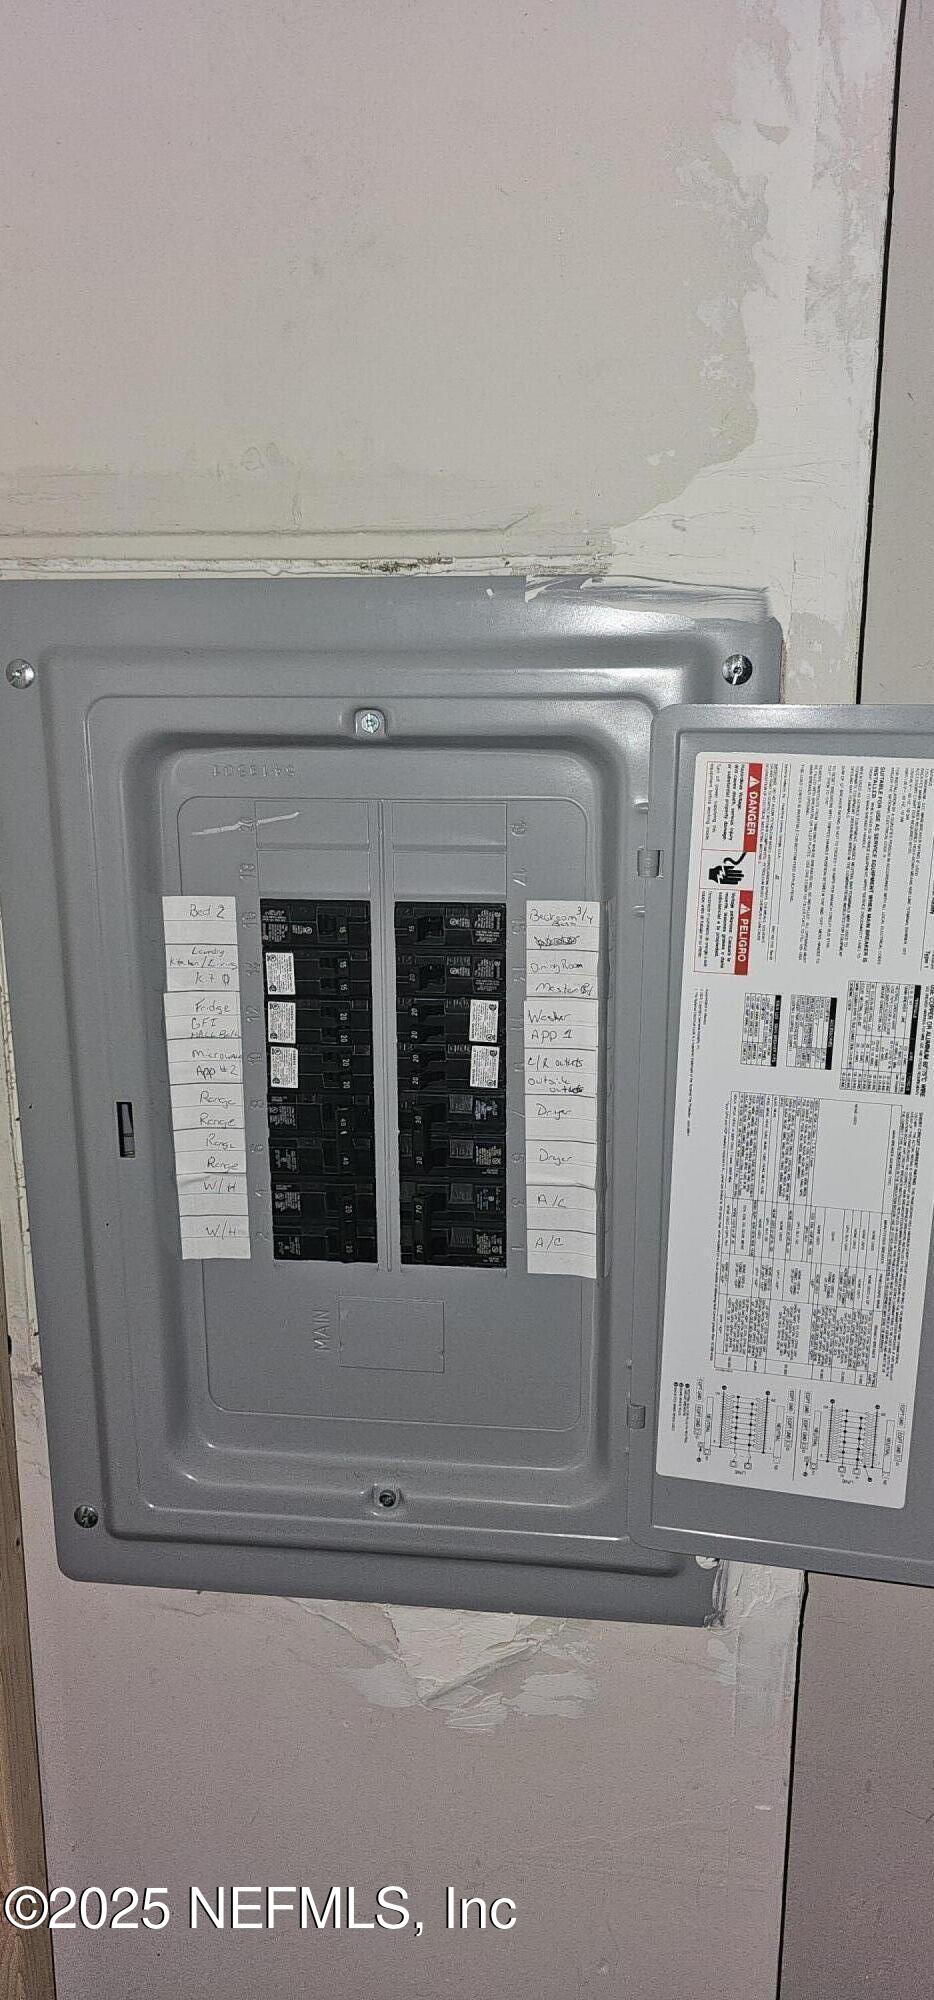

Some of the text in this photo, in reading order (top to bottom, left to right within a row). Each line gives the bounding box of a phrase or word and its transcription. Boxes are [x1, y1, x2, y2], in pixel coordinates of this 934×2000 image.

[877, 766, 885, 794] SUITABLE
[746, 791, 760, 835] DANGER
[874, 823, 880, 831] AS
[871, 833, 879, 858] SERVICE
[868, 860, 877, 893] EQUIPMENT
[190, 904, 225, 919] Bed 2
[736, 918, 749, 962] PELIGRO
[862, 930, 870, 956] BREAKER
[195, 998, 231, 1014] Fridge
[411, 1008, 418, 1017] 20
[340, 1012, 347, 1021] 20
[340, 1034, 348, 1043] 20
[411, 1031, 418, 1039] 20
[342, 1058, 349, 1067] 20
[412, 1054, 419, 1063] 20
[412, 1076, 419, 1085] 20
[200, 1113, 235, 1129] Range
[207, 1156, 239, 1172] Range
[313, 1310, 331, 1351] MAIN
